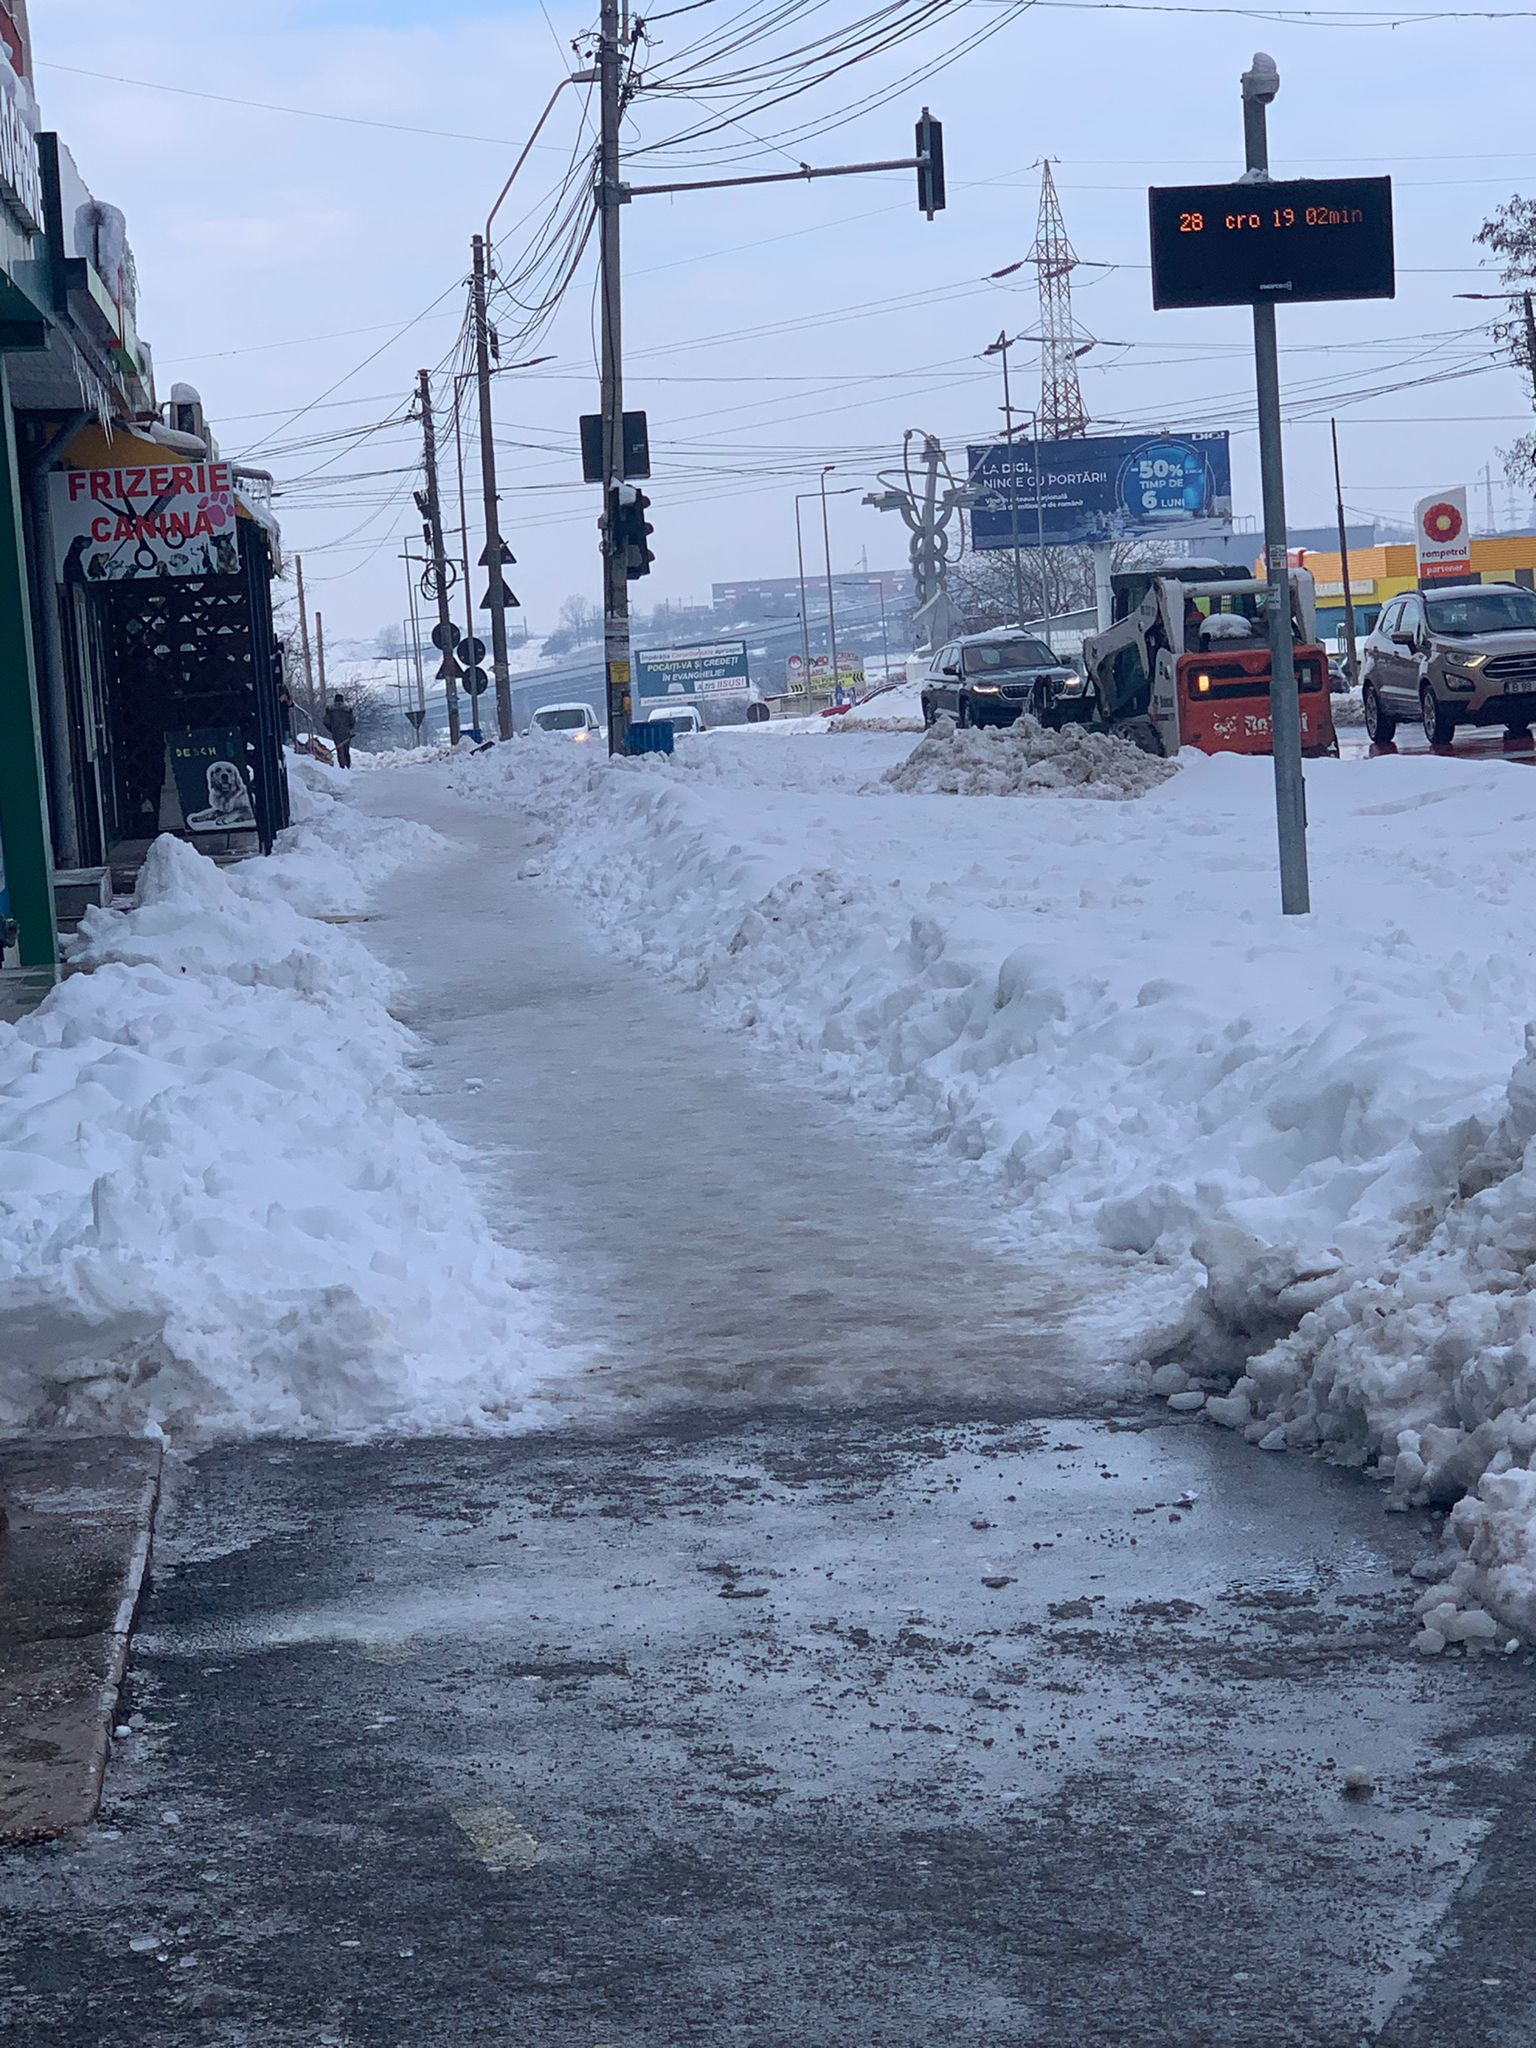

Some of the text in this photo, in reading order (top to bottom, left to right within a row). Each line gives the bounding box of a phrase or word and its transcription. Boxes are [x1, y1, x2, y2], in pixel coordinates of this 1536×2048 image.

[1179, 207, 1364, 232] 28 cro 19 02min
[982, 462, 1033, 475] LA DIGI,
[1130, 459, 1184, 479] -50%
[68, 463, 230, 501] FRIZERIE
[1048, 470, 1108, 486] PORTĂRI!
[1139, 478, 1184, 490] TIMP DE
[1141, 490, 1185, 509] 6 LUNI
[1421, 546, 1467, 559] rompetrol
